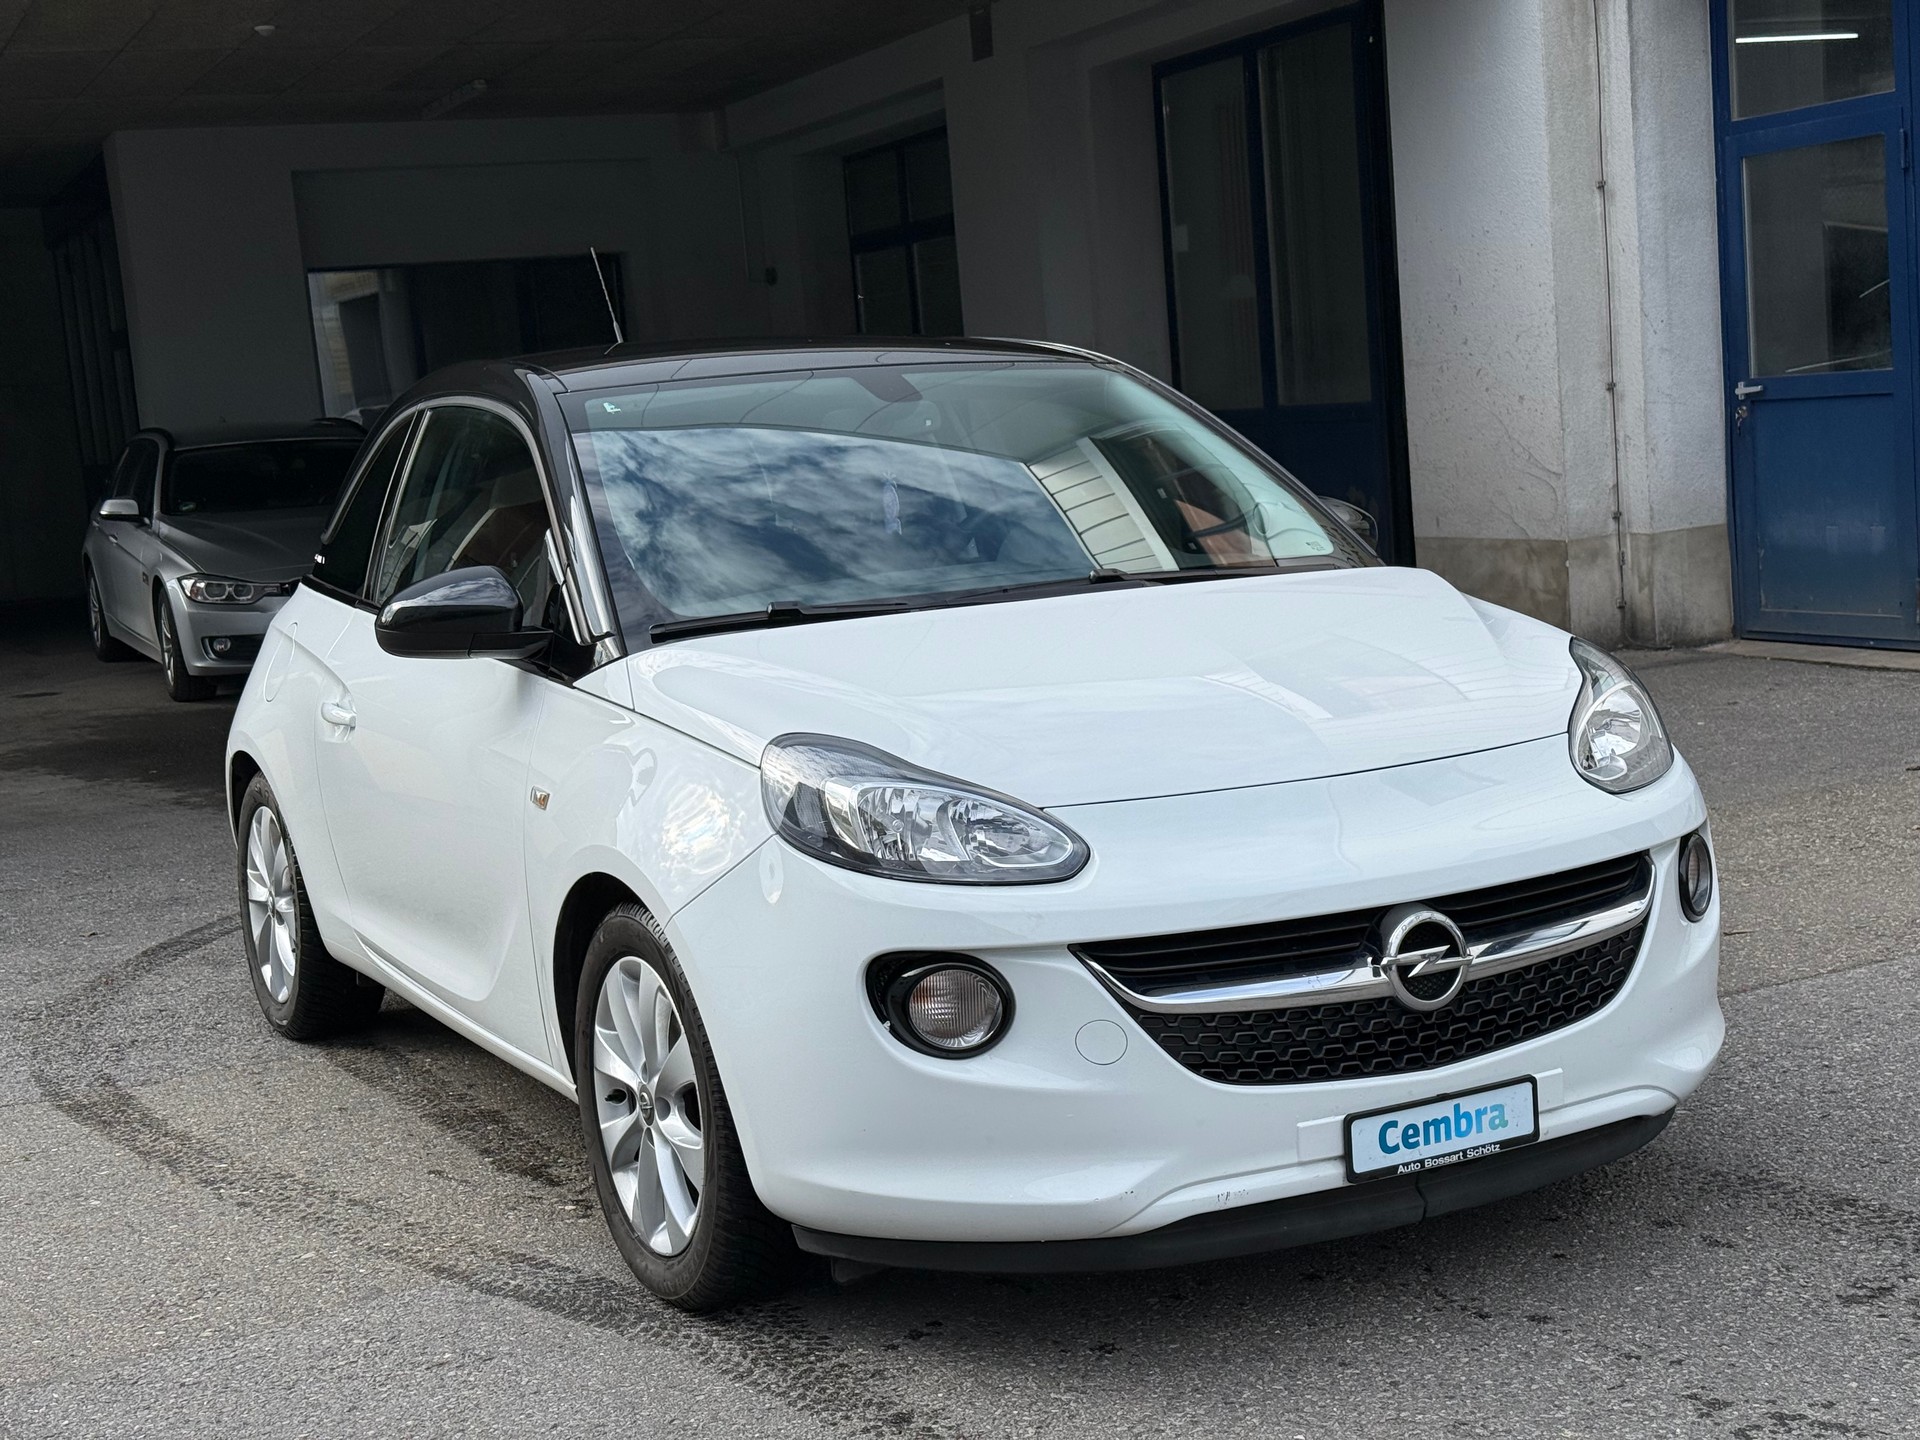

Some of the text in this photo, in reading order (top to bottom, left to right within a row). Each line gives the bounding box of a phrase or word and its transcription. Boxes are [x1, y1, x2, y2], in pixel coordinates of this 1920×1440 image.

[1378, 1103, 1508, 1154] Cembra
[1397, 1144, 1500, 1174] Auto Bossart Schötz
